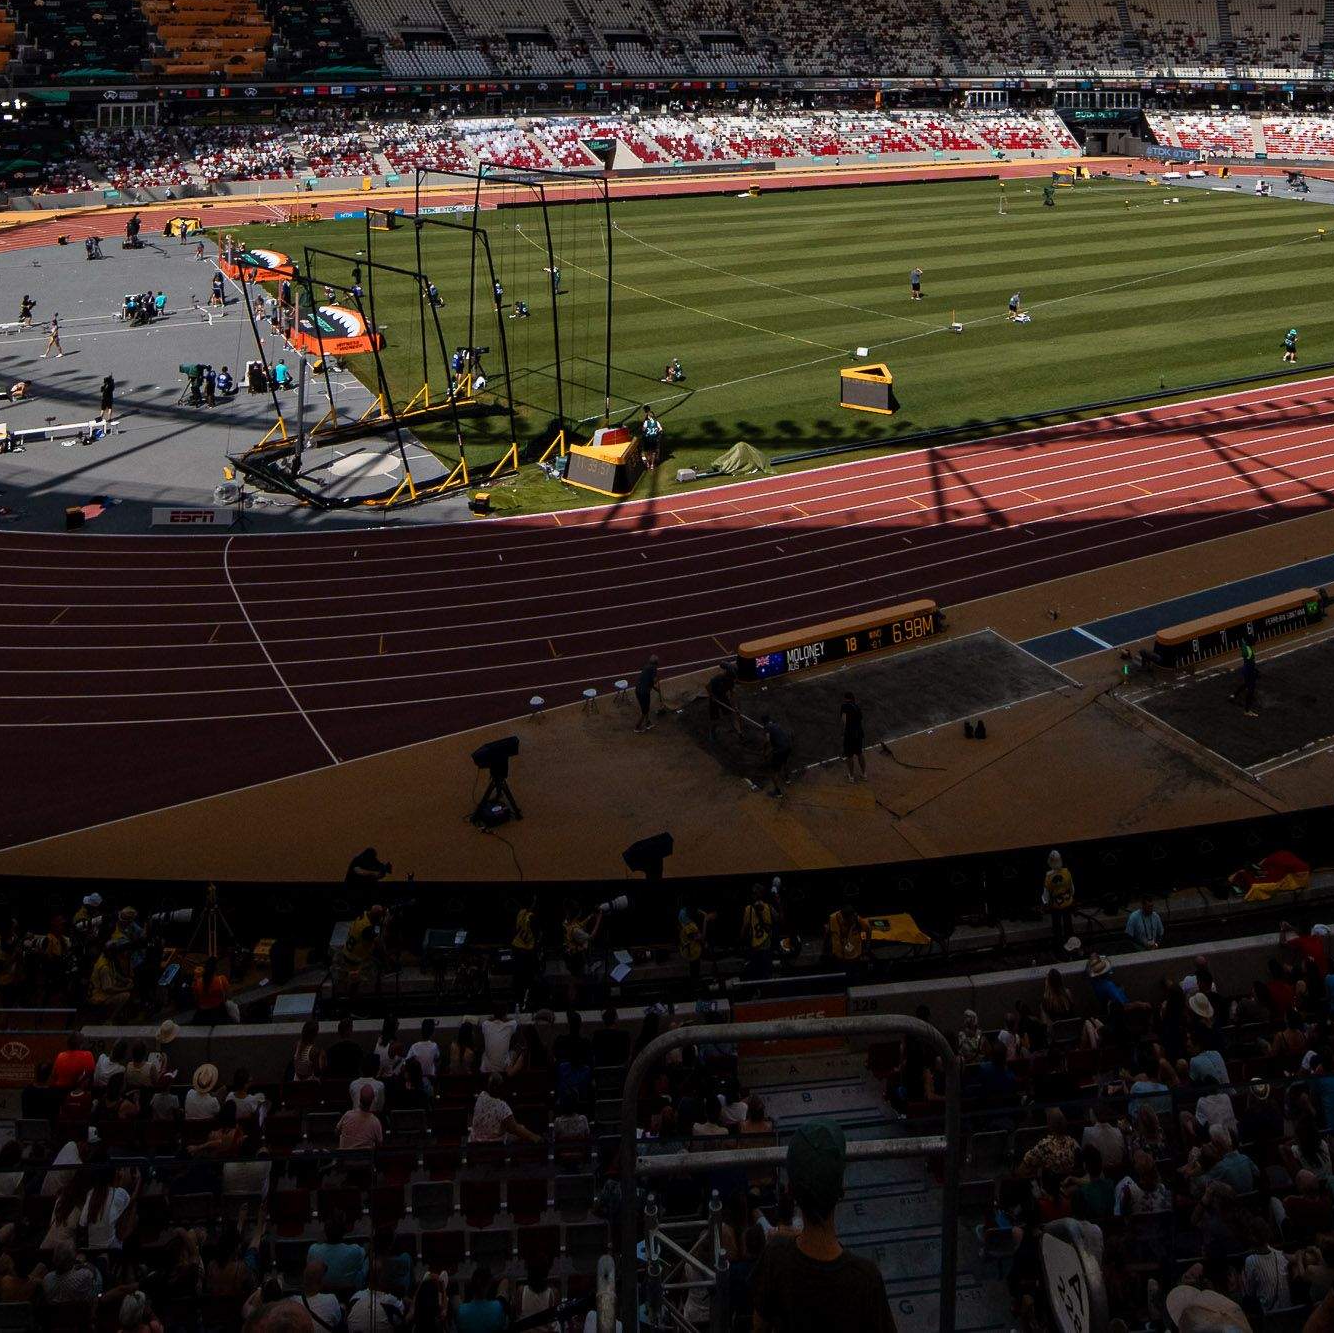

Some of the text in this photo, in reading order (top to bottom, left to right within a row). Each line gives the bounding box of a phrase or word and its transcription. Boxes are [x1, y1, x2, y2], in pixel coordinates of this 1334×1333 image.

[170, 510, 215, 523] ESPN
[891, 614, 935, 645] 6.98M
[787, 636, 858, 664] MOLONEY 18
